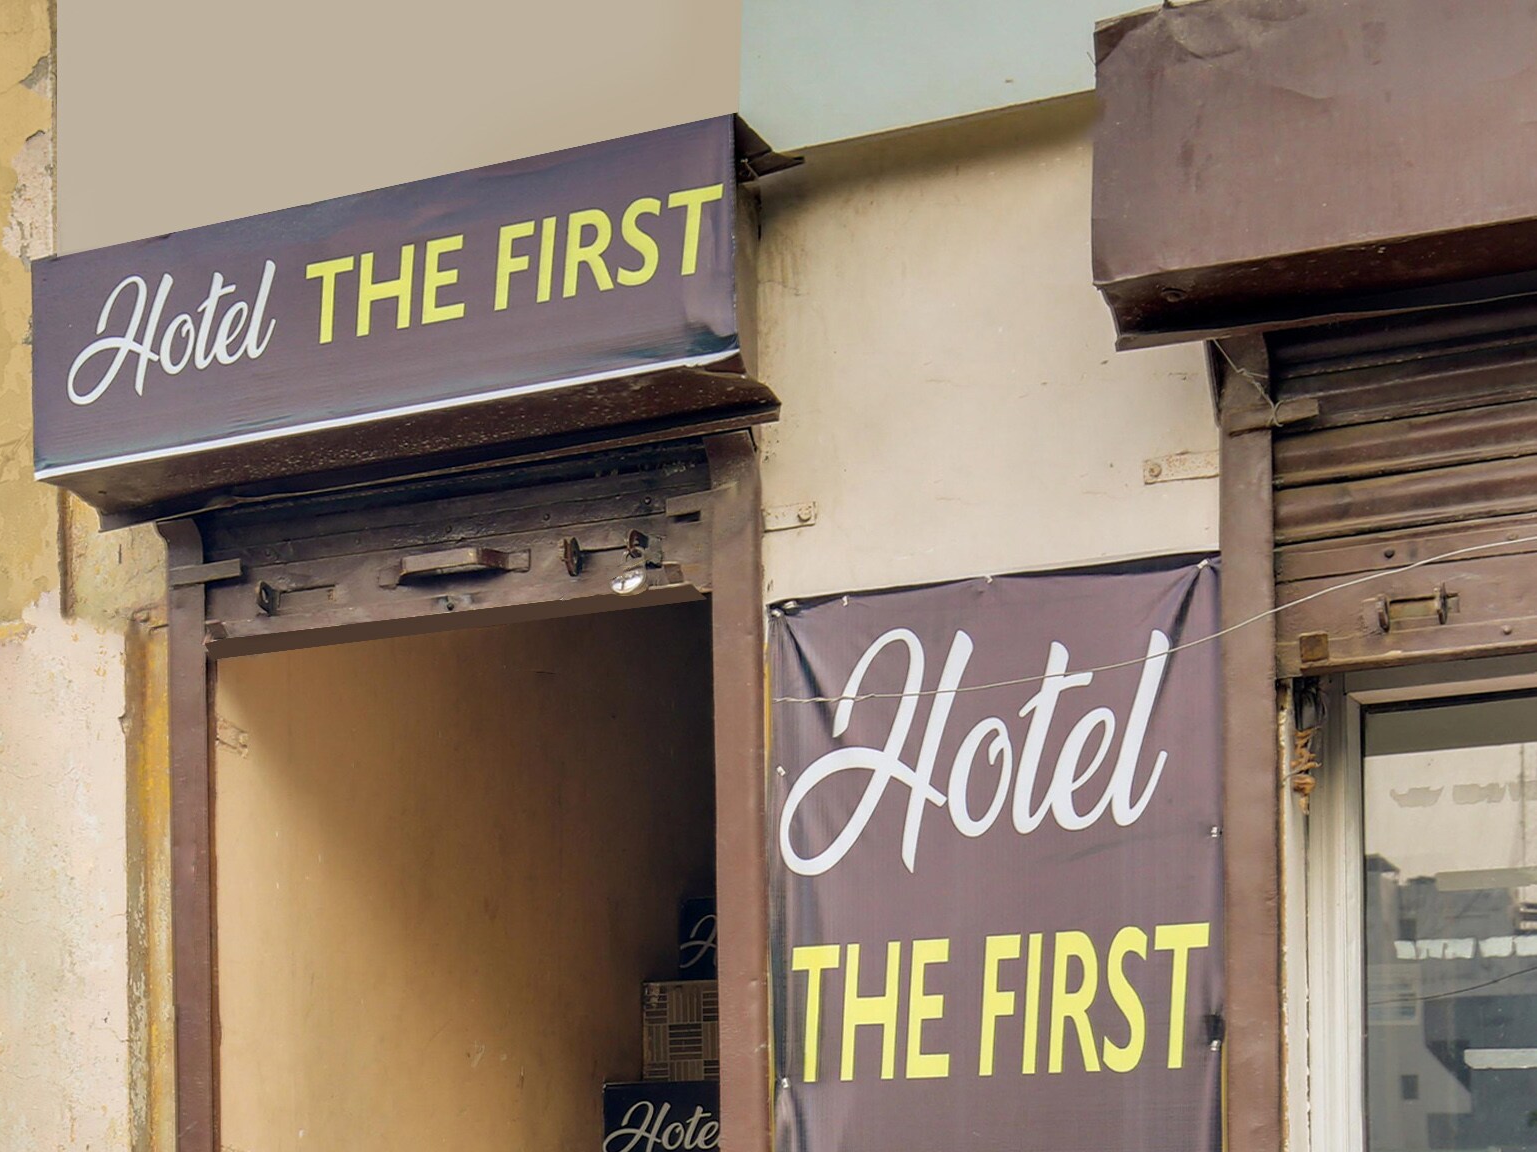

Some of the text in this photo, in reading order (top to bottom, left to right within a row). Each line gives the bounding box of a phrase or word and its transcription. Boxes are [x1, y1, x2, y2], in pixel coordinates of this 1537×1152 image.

[67, 184, 724, 406] Hotel THE FIRST
[779, 628, 1171, 877] Hotel
[792, 922, 1210, 1083] THE FIRST
